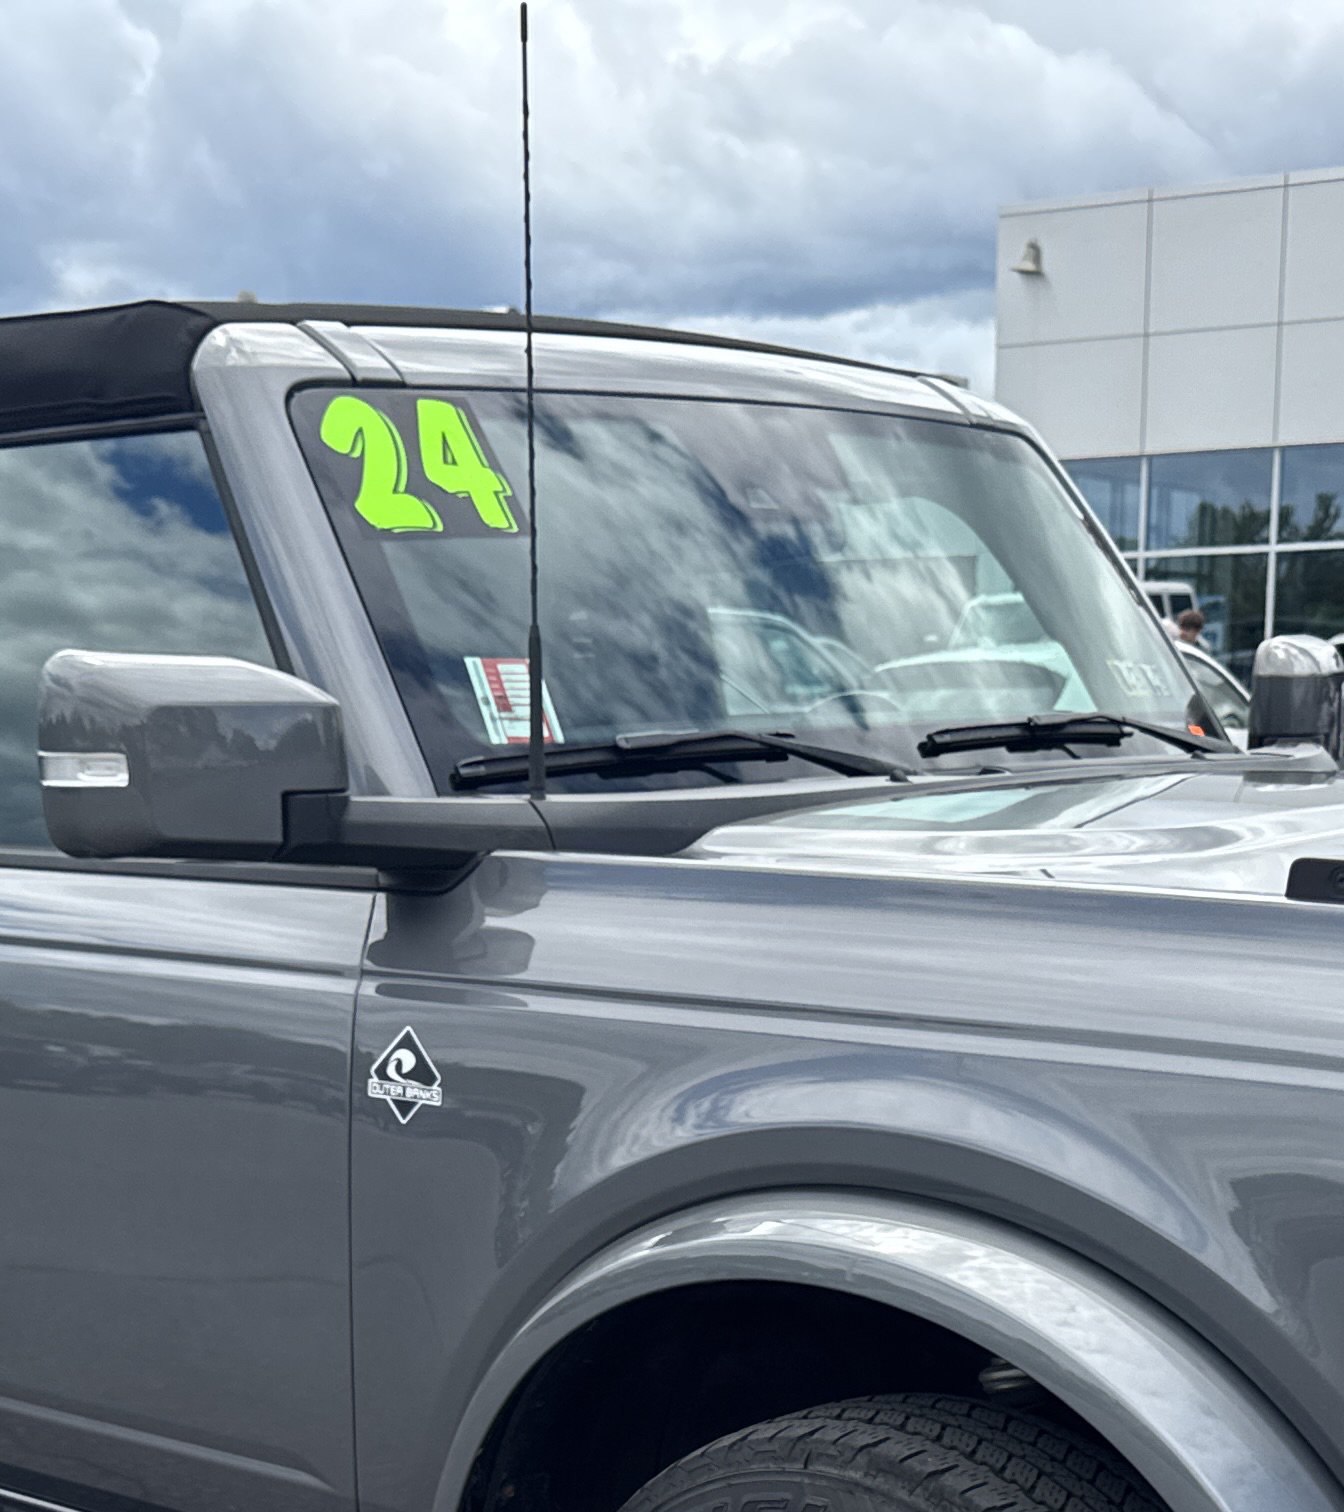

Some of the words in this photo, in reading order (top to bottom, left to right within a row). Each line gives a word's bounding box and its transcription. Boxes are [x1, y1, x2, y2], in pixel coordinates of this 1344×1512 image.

[321, 396, 518, 533] 24
[372, 1083, 404, 1097] OUTER
[405, 1087, 439, 1102] BANKS
